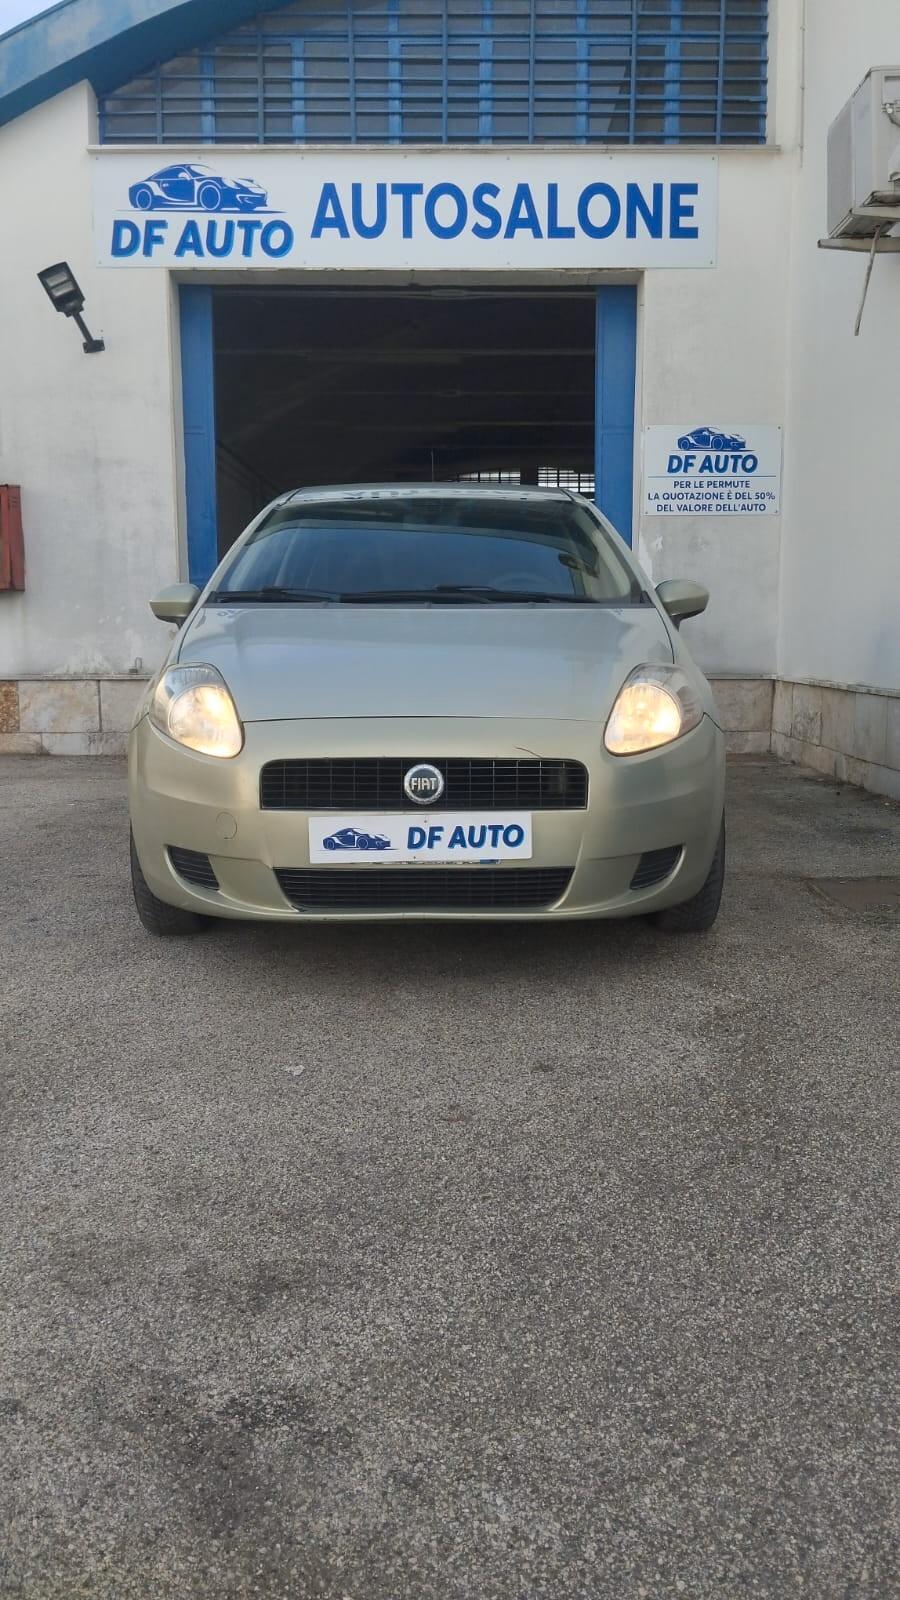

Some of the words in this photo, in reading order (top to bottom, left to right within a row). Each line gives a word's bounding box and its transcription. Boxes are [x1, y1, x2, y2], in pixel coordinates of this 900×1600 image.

[310, 182, 700, 239] AUTOSALONE
[110, 219, 168, 258] DF
[174, 219, 295, 258] AUTO
[667, 454, 697, 474] DF
[698, 454, 759, 474] AUTO
[673, 480, 691, 489] PER
[693, 480, 705, 489] LE
[706, 480, 751, 489] PERMUTE
[648, 492, 660, 501] LA
[662, 492, 725, 501] QUOTAZIONE
[735, 492, 752, 500] DEL
[754, 491, 776, 500] 50%
[656, 504, 674, 512] DEL
[676, 504, 713, 512] VALORE
[716, 503, 767, 512] DELL'AUTO
[410, 776, 438, 791] FIAT
[407, 825, 445, 850] DF
[448, 824, 525, 849] AUTO
